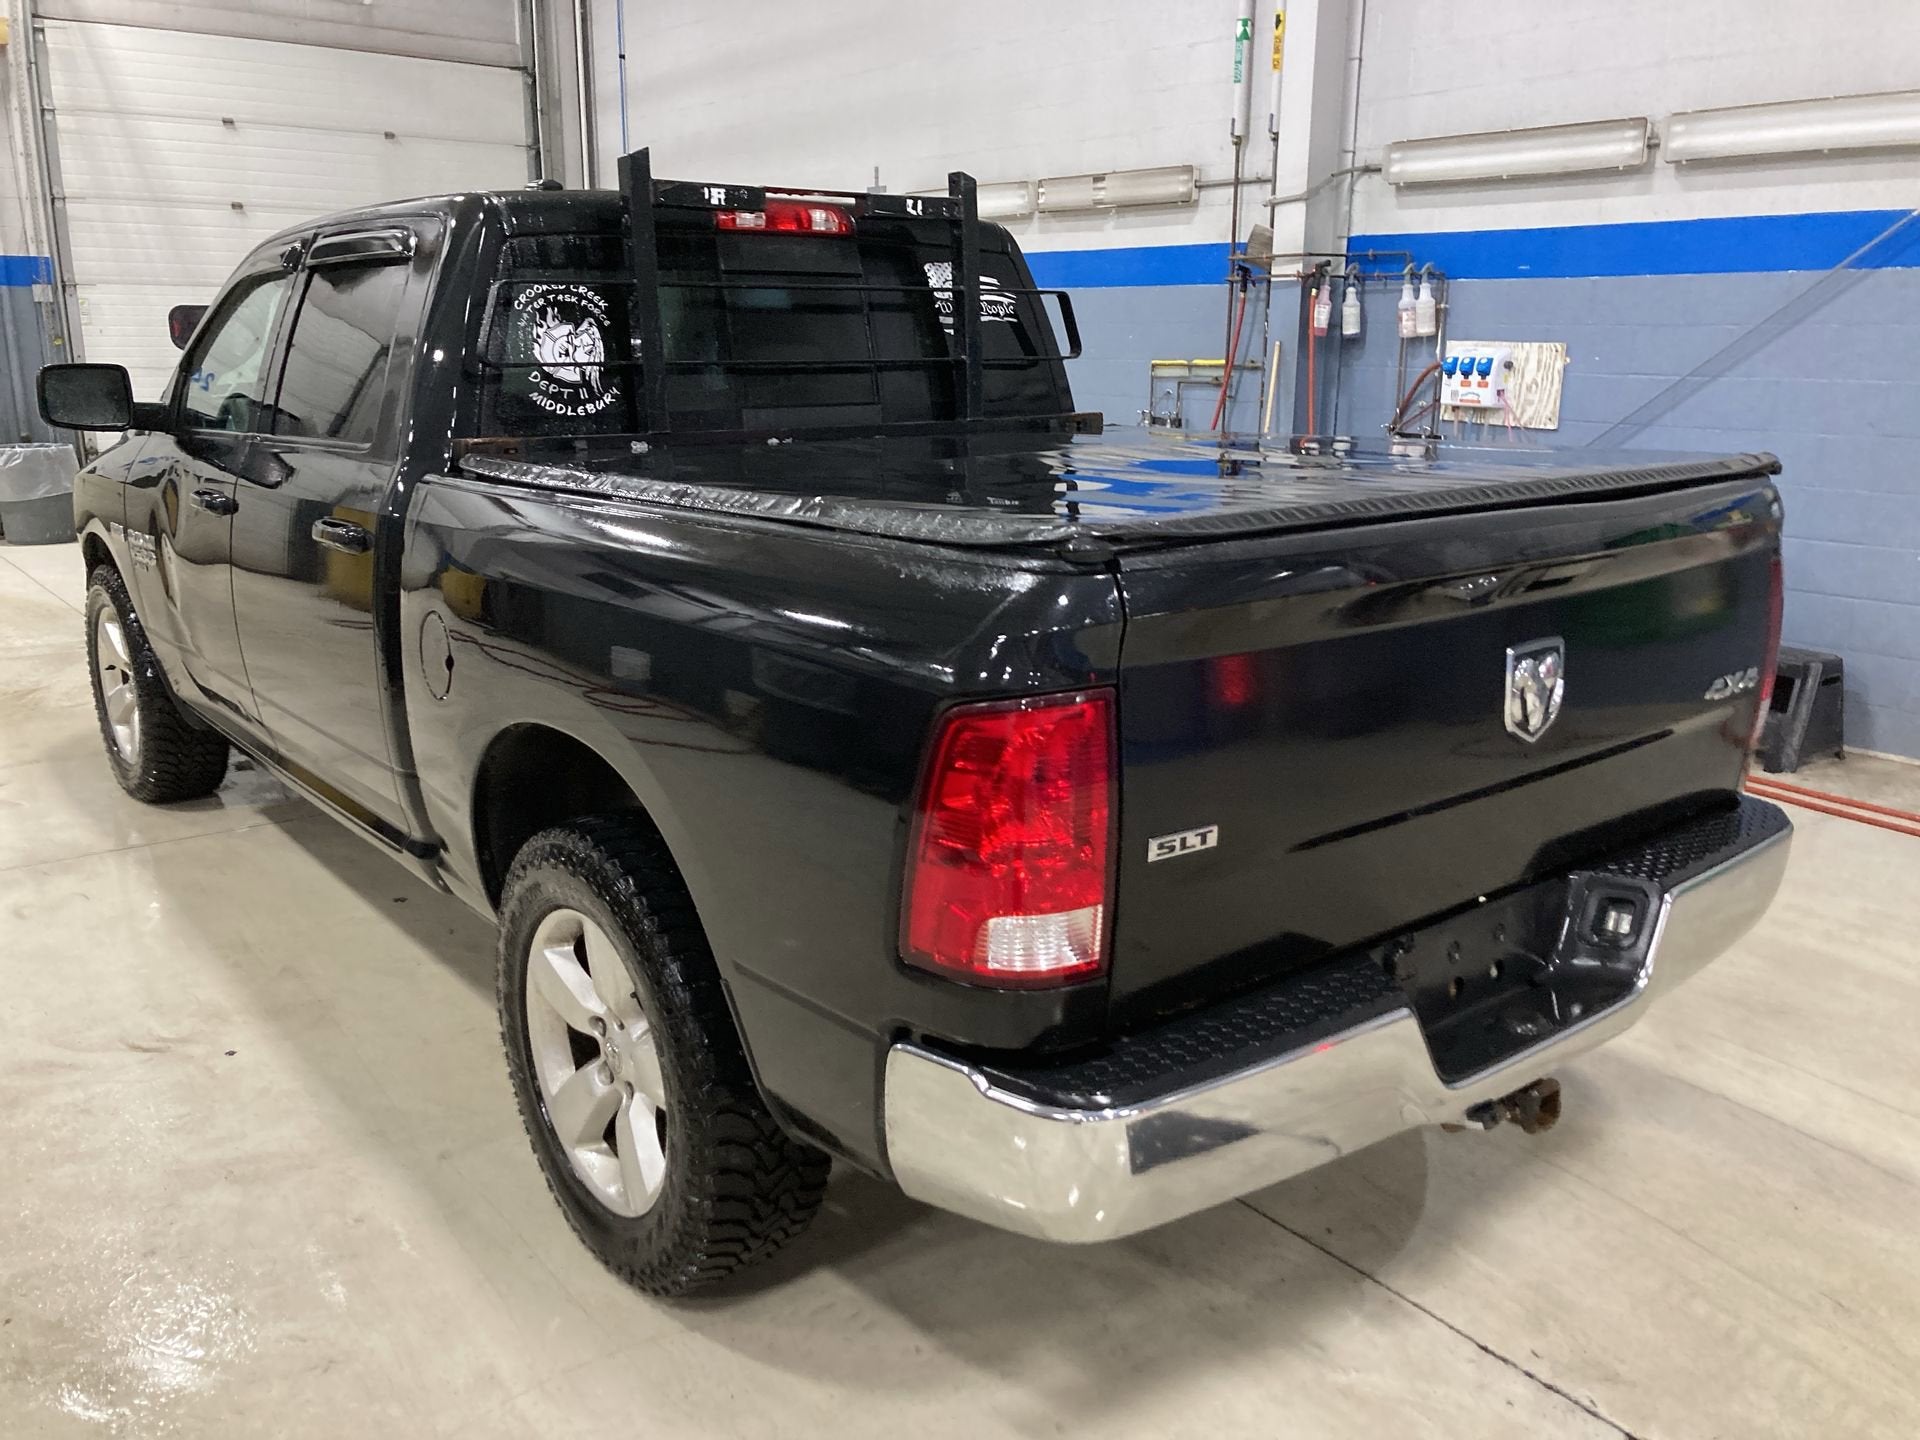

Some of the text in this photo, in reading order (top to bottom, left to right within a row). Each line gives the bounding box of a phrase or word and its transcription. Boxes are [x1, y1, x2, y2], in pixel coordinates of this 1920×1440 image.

[546, 294, 579, 304] TASK
[570, 284, 609, 311] CREEK
[979, 301, 1015, 317] People
[528, 371, 574, 399] DEPT
[529, 386, 621, 416] MIDDLEBURY
[1156, 828, 1214, 858] SLT
